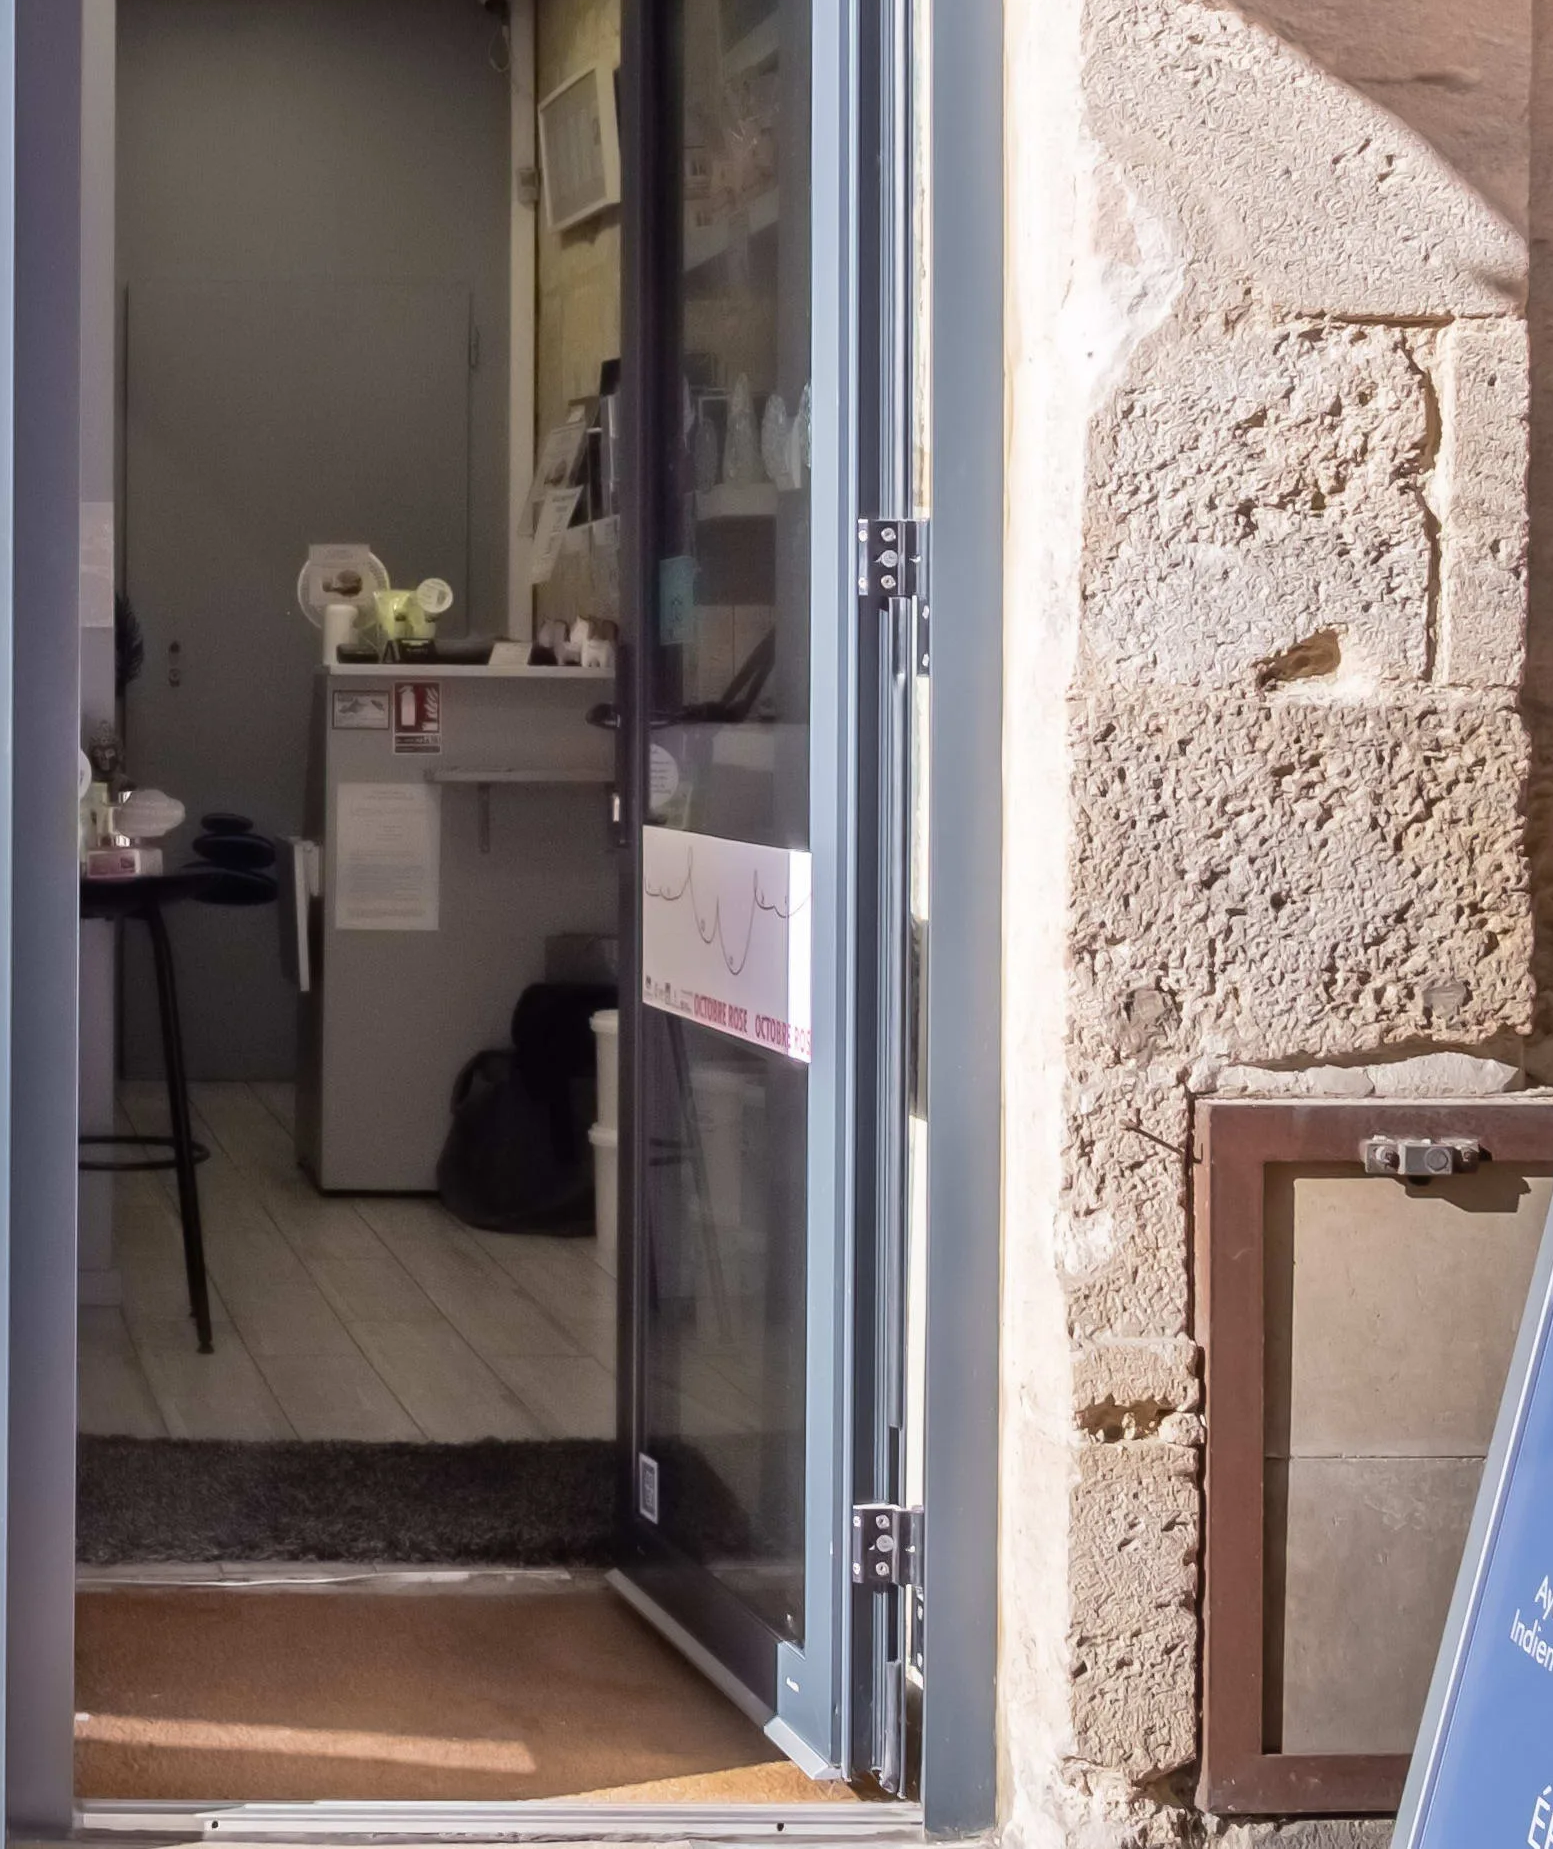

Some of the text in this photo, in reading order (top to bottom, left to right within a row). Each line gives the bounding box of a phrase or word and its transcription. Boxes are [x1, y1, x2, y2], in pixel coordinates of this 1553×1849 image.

[693, 994, 727, 1026] OCTOBRE
[728, 1004, 748, 1033] ROSE
[755, 1014, 792, 1049] OCTOBRE
